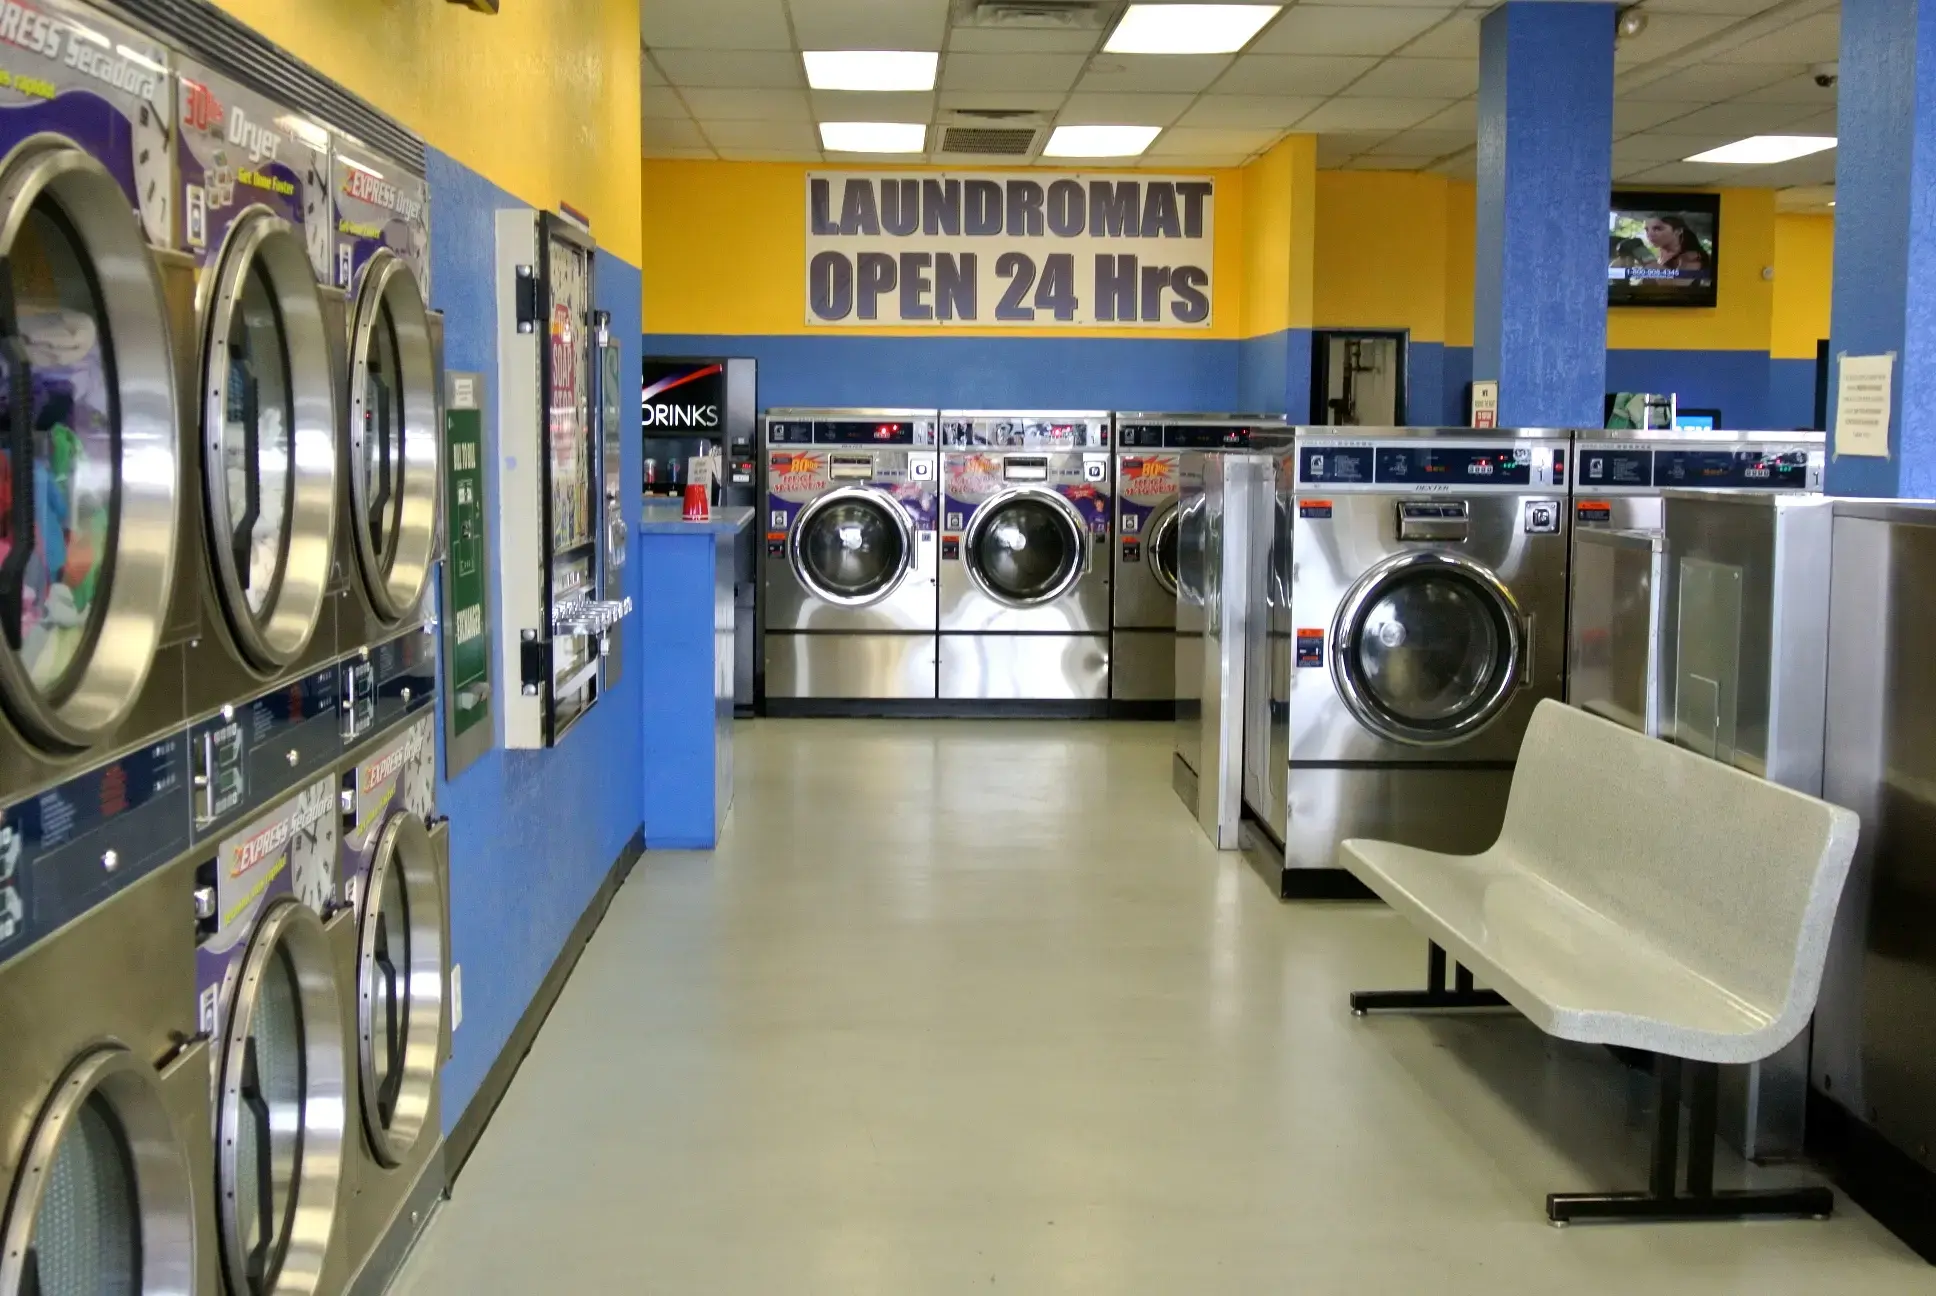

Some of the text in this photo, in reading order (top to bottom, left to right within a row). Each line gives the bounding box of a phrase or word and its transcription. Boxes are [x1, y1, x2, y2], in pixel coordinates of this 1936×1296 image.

[0, 1, 156, 101] RESS Secadora
[228, 105, 281, 163] Dryer
[352, 170, 421, 221] EXPRESS Dryer
[809, 177, 1213, 239] LAUNDROMAT
[809, 250, 1211, 324] OPEN 24 Hrs
[553, 343, 571, 388] SOAP
[369, 746, 404, 788] EXPRESS
[240, 793, 333, 871] EXPRESS Secadora
